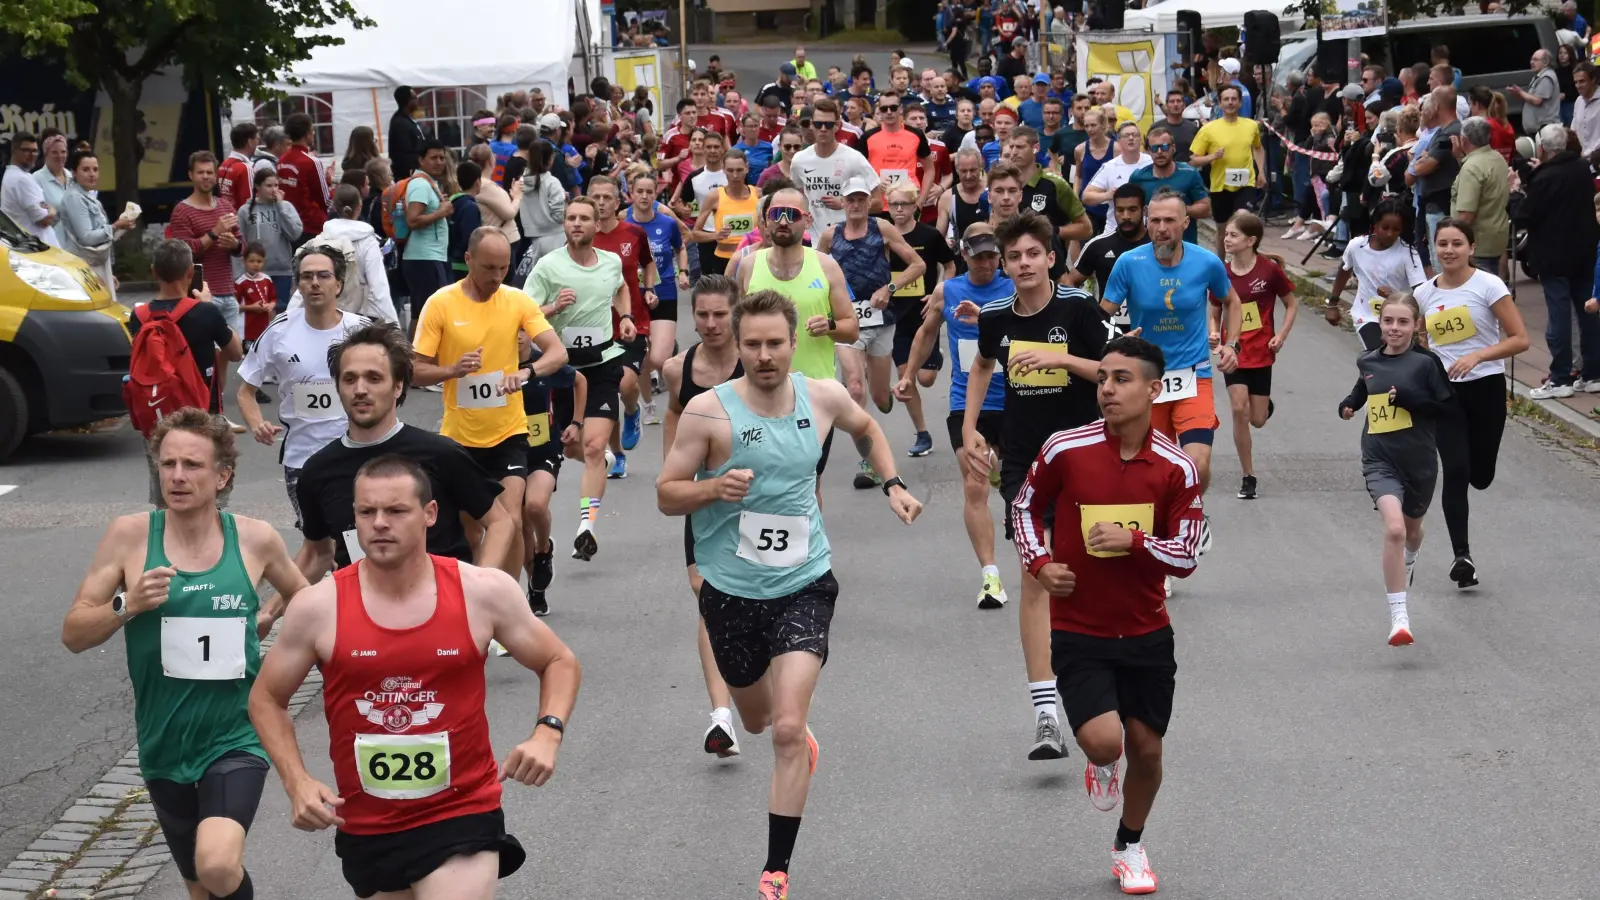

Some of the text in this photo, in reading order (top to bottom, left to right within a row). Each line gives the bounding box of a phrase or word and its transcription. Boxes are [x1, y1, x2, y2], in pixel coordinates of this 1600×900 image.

[806, 176, 830, 184] NIKE
[888, 174, 900, 184] 17
[1232, 173, 1242, 182] 21
[805, 183, 841, 191] MOVING
[730, 220, 750, 230] 629
[1160, 278, 1181, 286] EAT A
[855, 307, 872, 319] 36
[1160, 317, 1178, 325] KEEP
[1435, 317, 1465, 336] 543
[572, 335, 592, 348] 43
[1050, 334, 1066, 342] FCN
[1163, 377, 1183, 393] 13
[469, 383, 491, 399] 10
[1016, 387, 1063, 396] VERSICHERUNG
[306, 393, 332, 409] 20
[1370, 404, 1397, 423] 547
[757, 528, 789, 552] 53
[183, 584, 209, 592] CRAFT
[211, 594, 243, 611] TSV
[197, 635, 210, 662] 1
[437, 648, 459, 656] Daniel
[369, 751, 437, 781] 628
